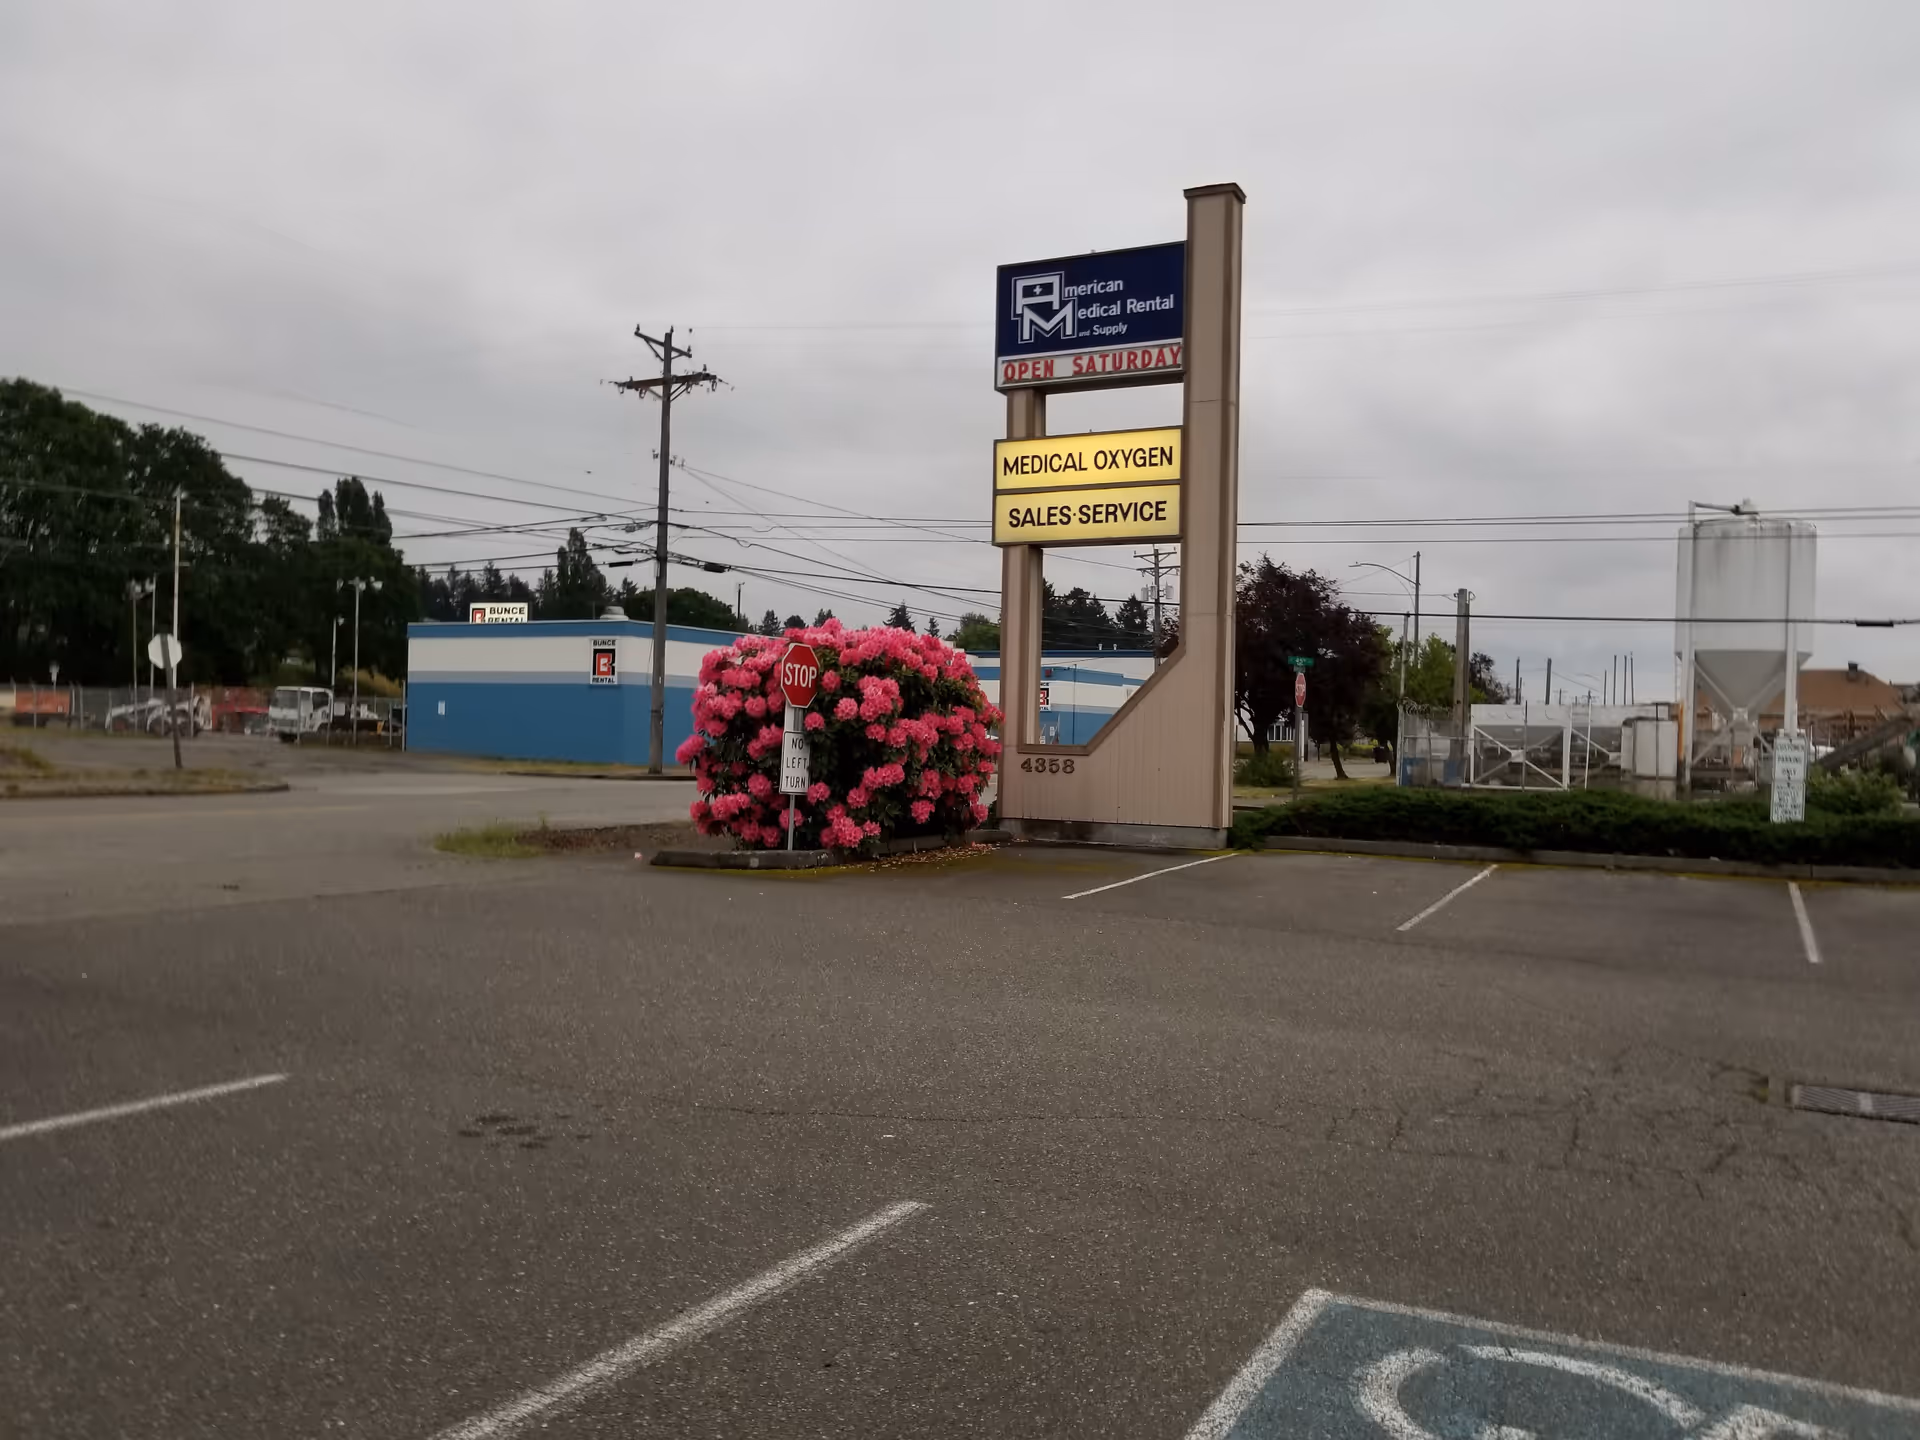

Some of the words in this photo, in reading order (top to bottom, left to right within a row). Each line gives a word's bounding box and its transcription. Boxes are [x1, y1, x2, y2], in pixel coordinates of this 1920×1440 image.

[1126, 294, 1174, 314] Rental
[1092, 322, 1128, 336] Supply
[1004, 359, 1055, 381] OPEN
[1072, 345, 1182, 375] SATURDAY
[1003, 451, 1088, 476] MEDICAL
[1094, 446, 1174, 469] OXYGEN
[489, 606, 525, 615] BUNCE
[784, 662, 818, 688] STOP
[791, 738, 804, 750] NO
[786, 757, 808, 769] LEFT
[1020, 757, 1075, 774] 4358
[785, 776, 806, 788] TURN
